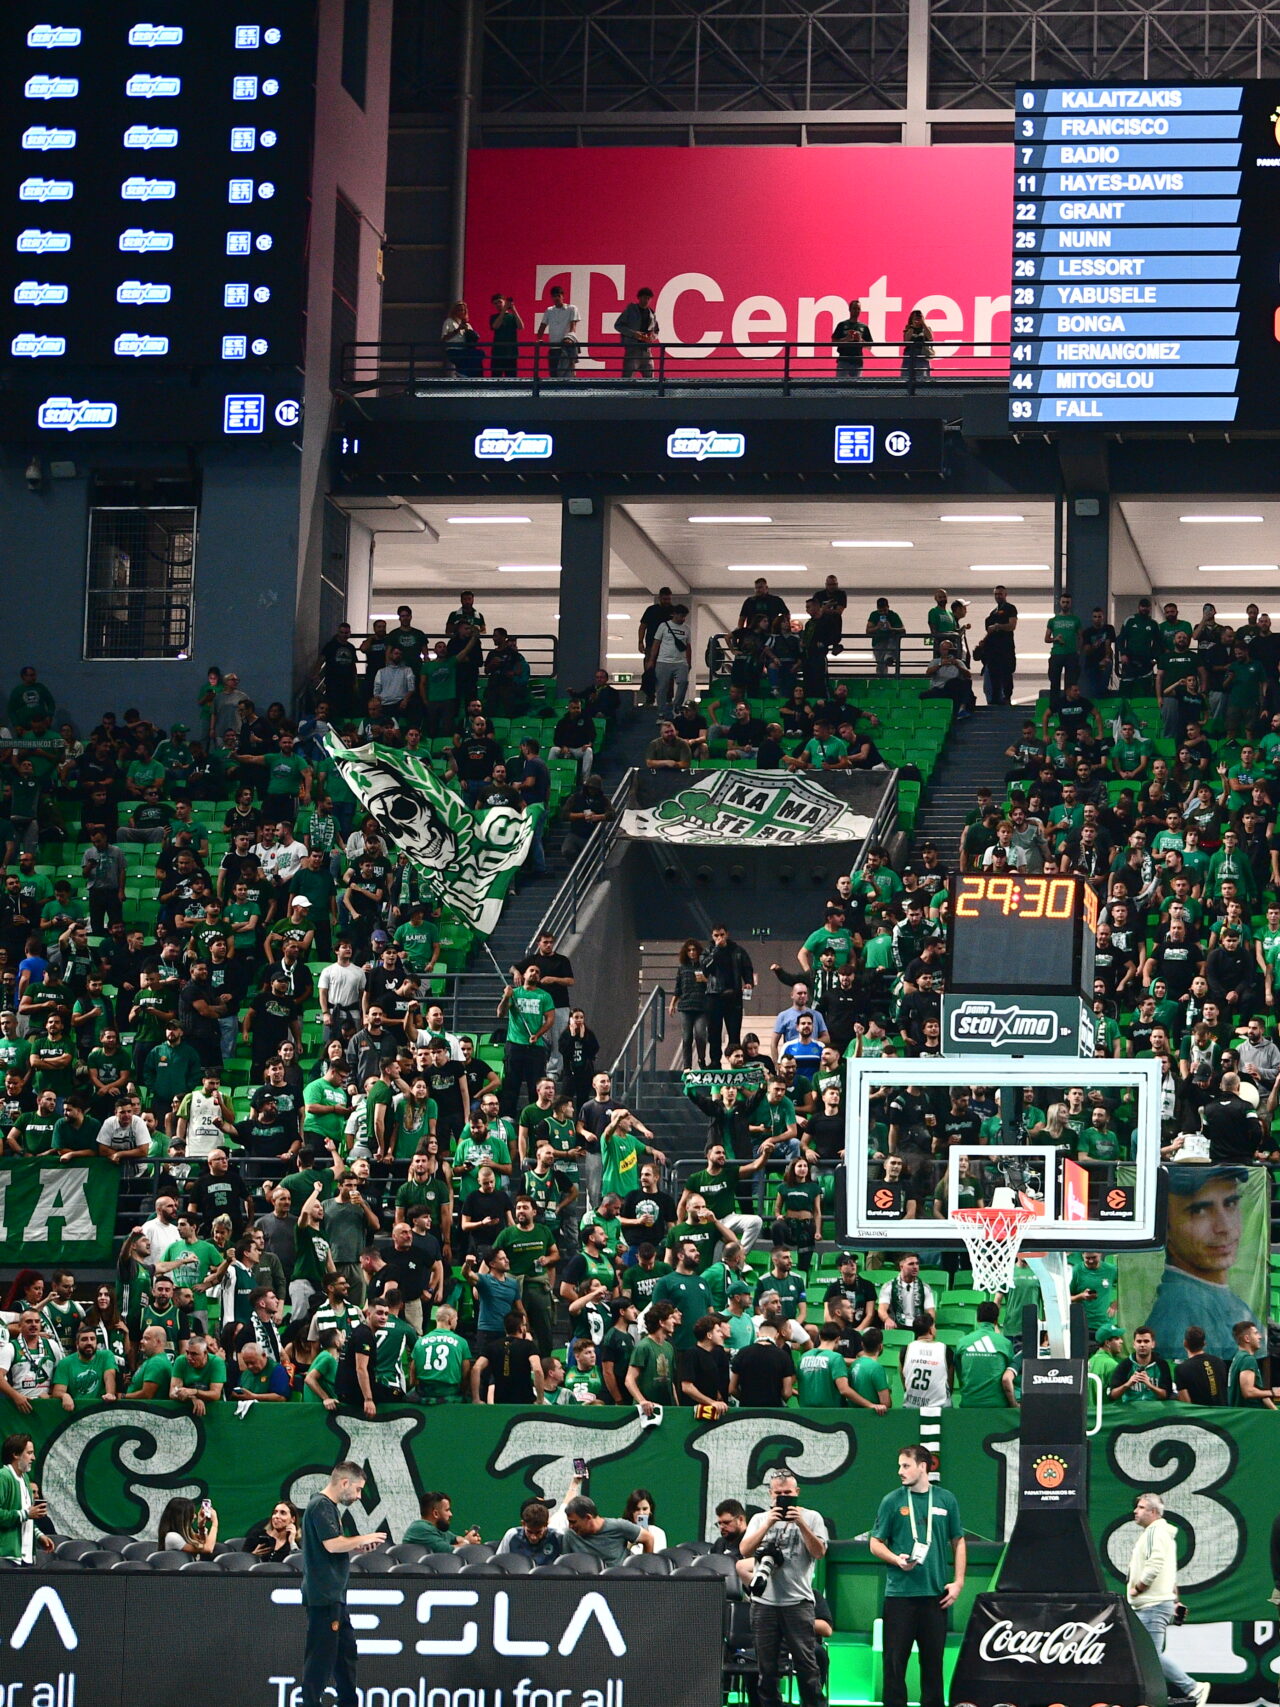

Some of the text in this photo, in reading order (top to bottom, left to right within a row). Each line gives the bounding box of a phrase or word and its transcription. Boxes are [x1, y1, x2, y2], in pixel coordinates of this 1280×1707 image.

[1022, 90, 1181, 109] 0 KALAITZAKIS
[1022, 118, 1168, 136] 3 FRANCISCO
[1022, 146, 1119, 163] 7 BADIO
[1018, 174, 1183, 191] 11 HAYES-DAVIS
[1017, 203, 1124, 219] 22 GRANT
[1016, 231, 1111, 248] 25 NUNN
[1015, 259, 1144, 276] 26 LESSORT
[1015, 287, 1156, 304] 28 YABUSELE
[654, 272, 1012, 360] Center
[1014, 316, 1125, 332] 32 BONGA
[1014, 343, 1180, 360] 41 HERNANGOMEZ
[1013, 372, 1153, 389] 44 MITOGLOU
[1012, 401, 1103, 417] 93 FALL
[955, 877, 1076, 919] 29:30
[424, 1344, 450, 1371] 13
[911, 1367, 931, 1391] 25
[1032, 1375, 1073, 1385] SPALDING
[979, 1619, 1114, 1666] Coca-Cola
[269, 1677, 624, 1707] Tenology for all
